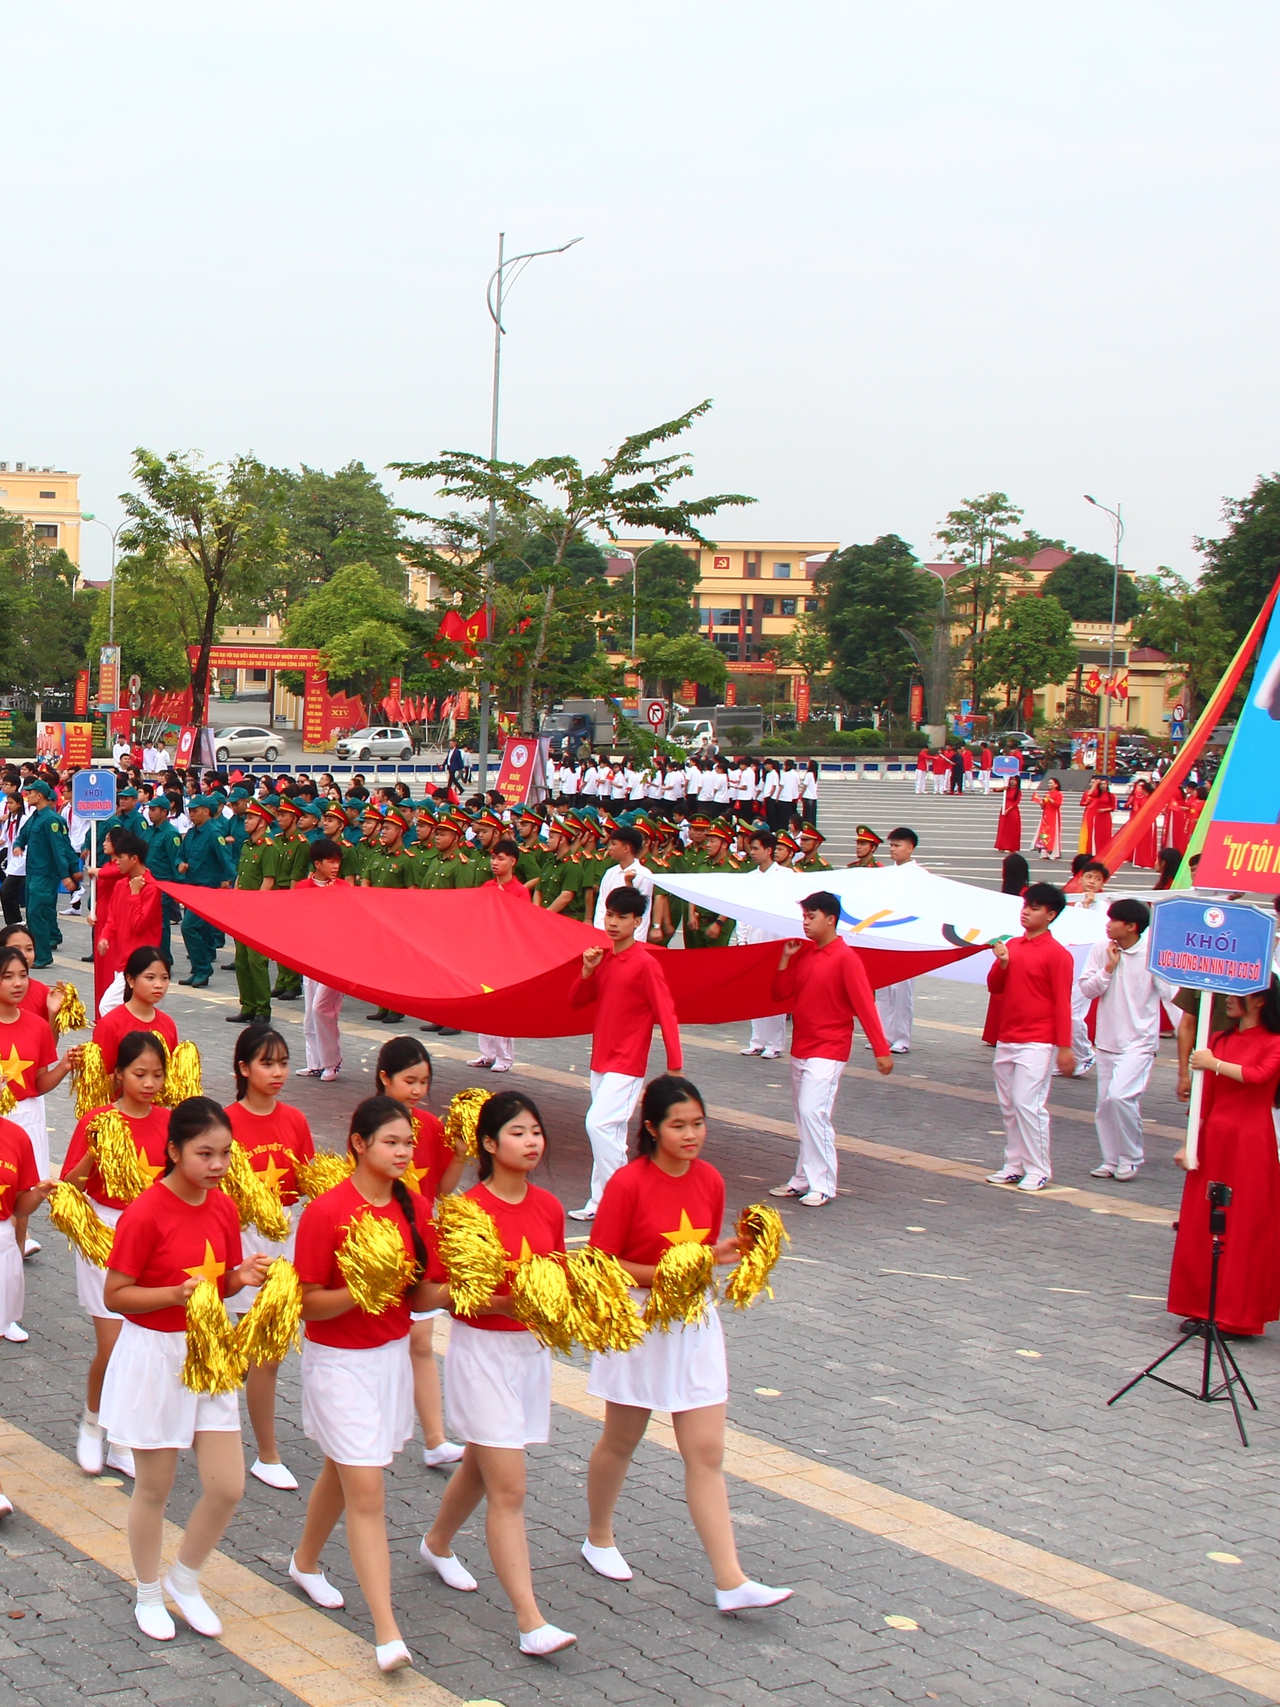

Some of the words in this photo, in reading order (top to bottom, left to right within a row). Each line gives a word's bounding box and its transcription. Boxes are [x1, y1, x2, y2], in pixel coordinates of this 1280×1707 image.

[85, 786, 103, 797] KHỐI
[1247, 839, 1274, 873] TÔI
[1185, 930, 1237, 953] KHỐI
[1158, 950, 1173, 970] LỰC
[1173, 951, 1198, 973] LƯỢNG
[1198, 956, 1209, 972] AN
[1210, 957, 1224, 976] NIN
[1226, 960, 1237, 980] TẠI
[1238, 960, 1249, 979] CƠ
[1250, 958, 1262, 981] SỞ
[267, 1142, 283, 1152] VIỆT
